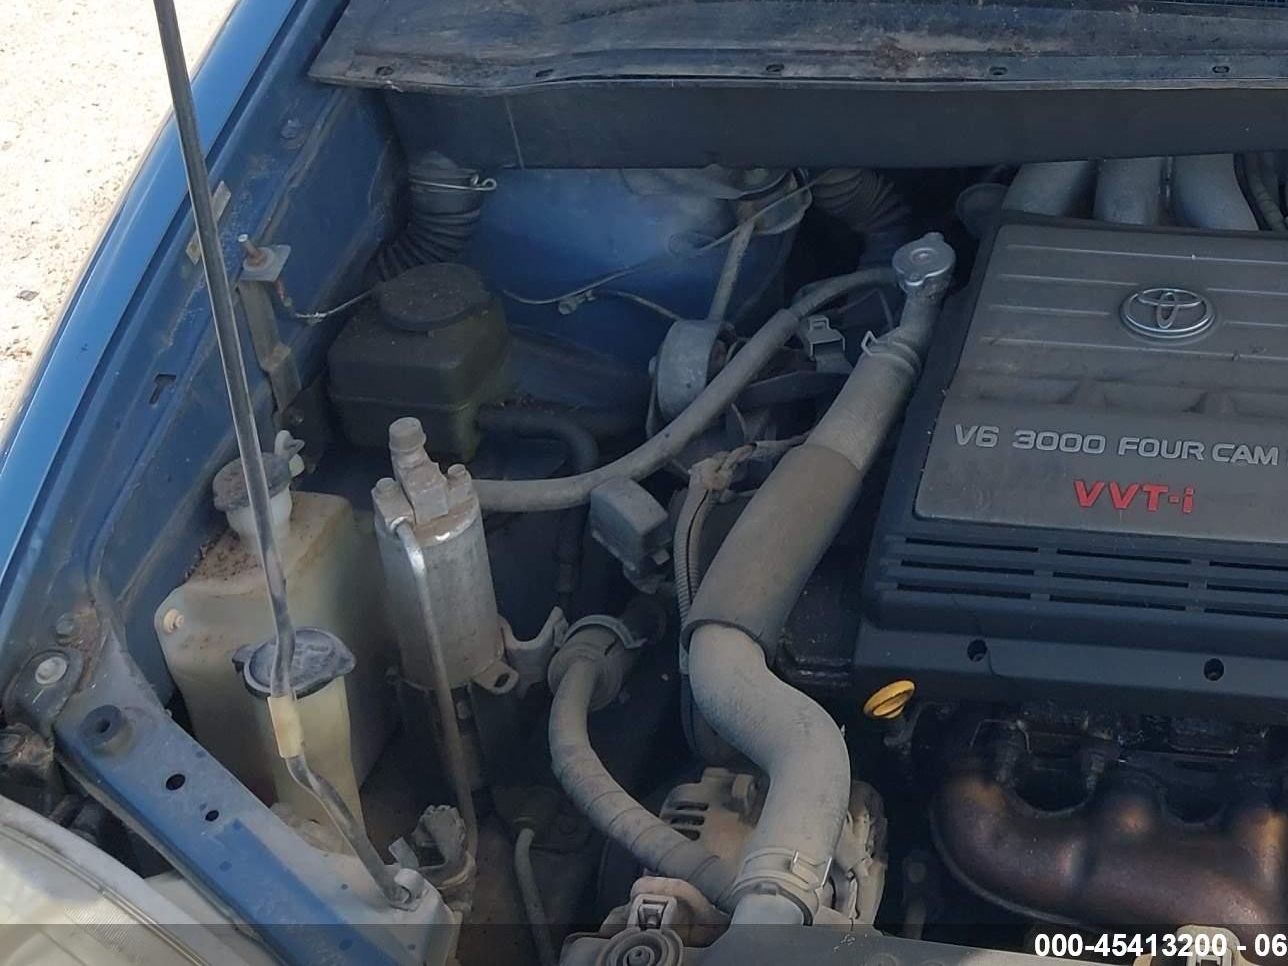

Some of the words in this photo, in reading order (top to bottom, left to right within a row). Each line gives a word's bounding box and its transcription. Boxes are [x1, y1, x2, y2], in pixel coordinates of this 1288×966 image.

[954, 424, 999, 448] V6
[1012, 430, 1105, 454] 3000
[1118, 437, 1204, 461] FOUR
[1211, 443, 1279, 466] CAM
[1073, 480, 1196, 514] VVT-i
